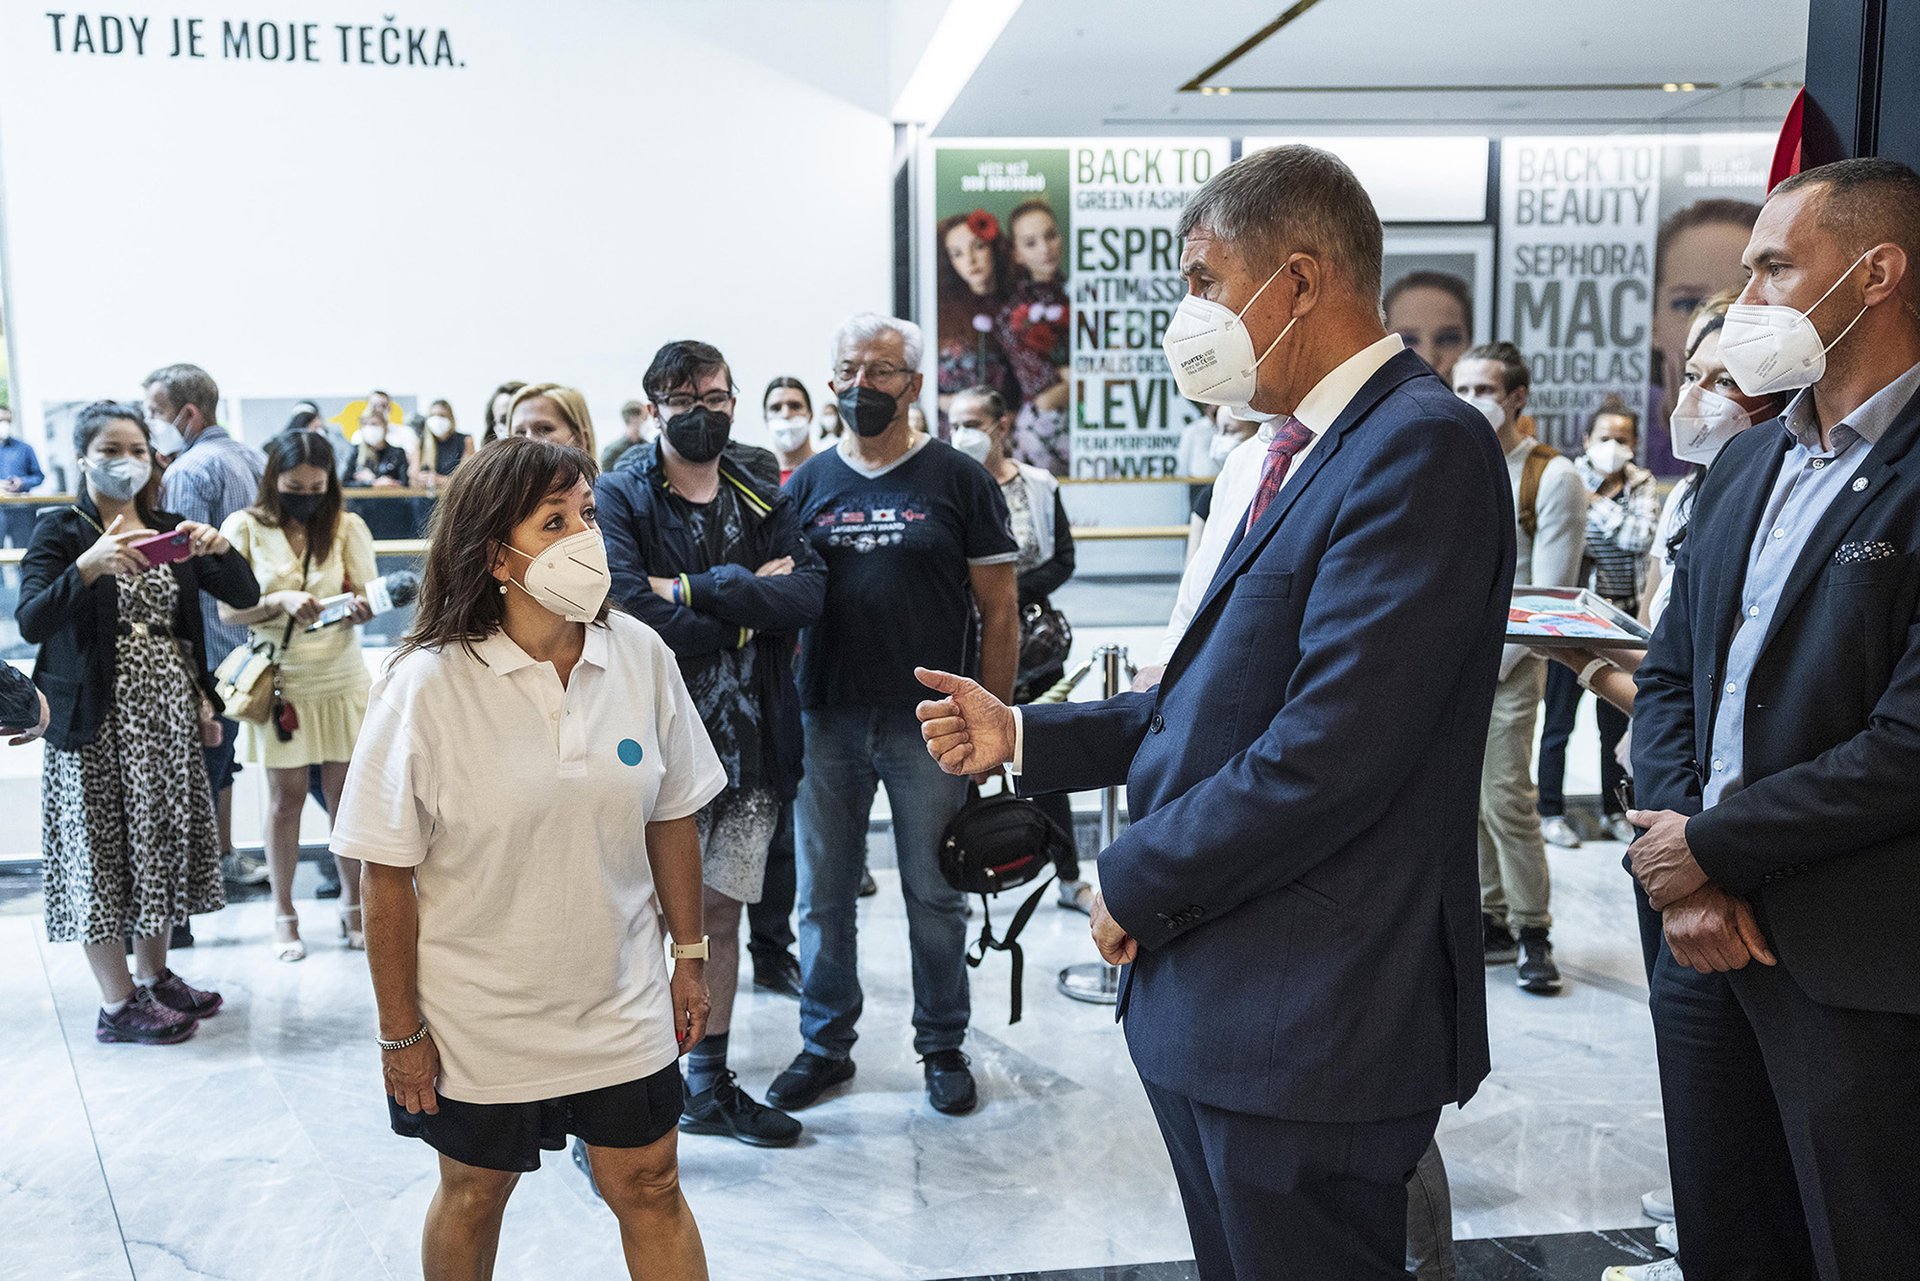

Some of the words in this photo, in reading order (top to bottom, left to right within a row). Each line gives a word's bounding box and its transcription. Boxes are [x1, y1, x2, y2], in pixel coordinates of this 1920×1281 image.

[46, 13, 149, 55] TADY
[170, 17, 205, 58] JE
[223, 20, 320, 63] MOJE
[336, 14, 466, 68] TEČKA.
[1077, 148, 1162, 184] BACK
[1171, 148, 1211, 184] TO
[1519, 147, 1603, 183] BACK
[1612, 147, 1653, 182] TO
[1076, 190, 1132, 211] GREEN
[1517, 187, 1649, 225] BEAUTY
[1077, 228, 1185, 271] ESPRI
[1515, 244, 1648, 276] SEPHORA
[1077, 310, 1170, 349] NEBB
[1512, 280, 1646, 348] MAC
[1523, 352, 1643, 384] OUGLAS
[1077, 378, 1192, 429] LEVI'
[1077, 456, 1177, 477] CONVER
